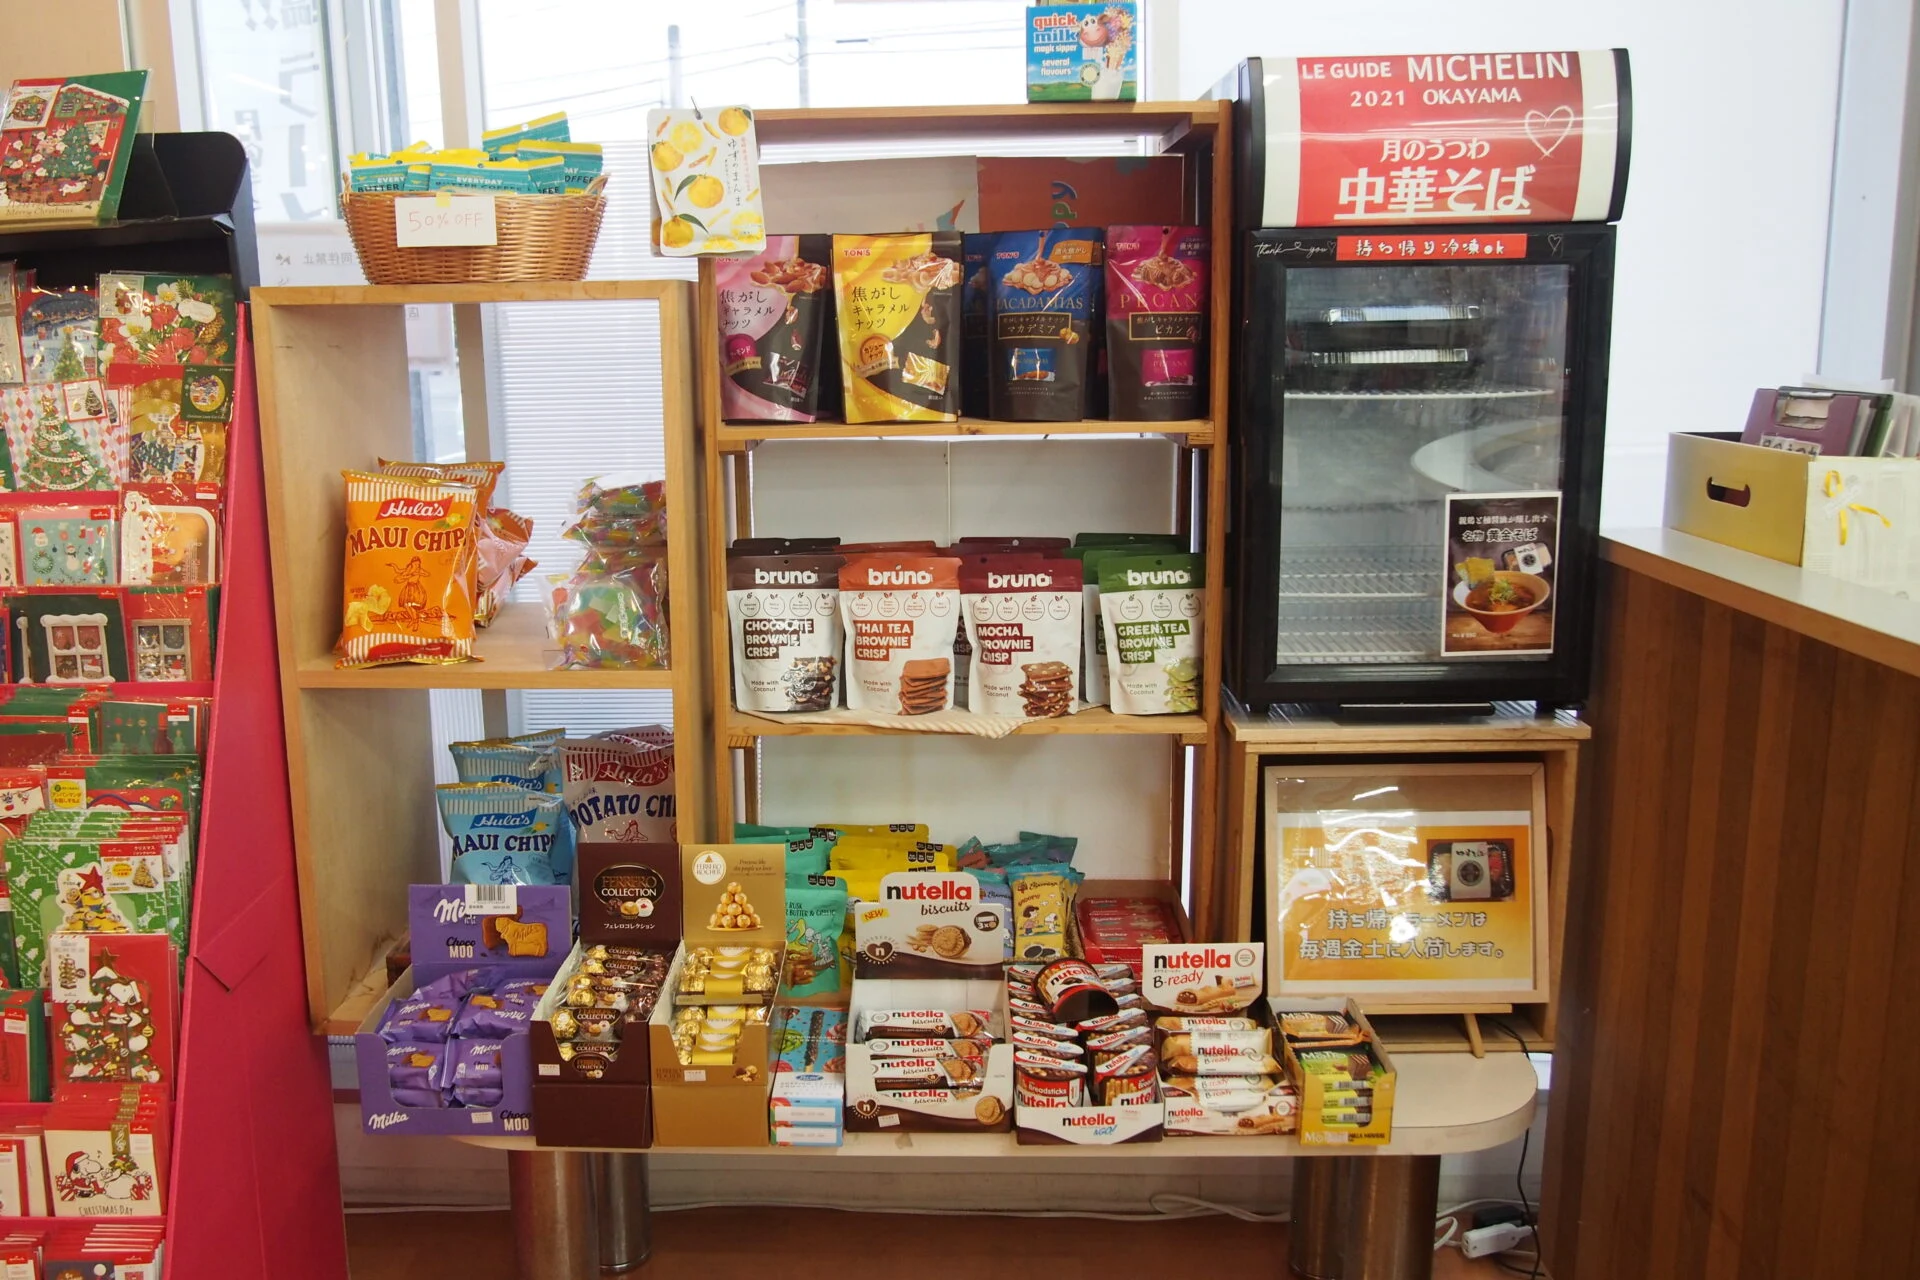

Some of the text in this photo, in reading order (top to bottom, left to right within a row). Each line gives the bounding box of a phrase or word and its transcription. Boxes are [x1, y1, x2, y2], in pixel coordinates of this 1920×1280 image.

[1034, 13, 1077, 30] quick
[1034, 28, 1078, 43] milk
[1034, 44, 1077, 54] magic sipper
[1042, 58, 1070, 66] several
[1302, 53, 1570, 83] LE GUIDE MICHELIN
[1041, 67, 1071, 76] flavours
[1351, 87, 1522, 107] 2021 OKAYAMA
[1379, 138, 1490, 162] 月のうつわ
[727, 138, 741, 206] ゆずのまんま
[456, 176, 502, 184] EVERYDAY
[1339, 164, 1536, 215] 中華そば
[409, 211, 484, 232] 50% OFF
[844, 249, 871, 257] TON'S
[720, 289, 767, 303] 焦がし
[852, 286, 900, 302] 焦がし
[721, 307, 775, 316] キャラメル
[852, 304, 910, 315] キャラメル
[722, 318, 751, 330] ナッツ
[855, 318, 886, 330] ナッツ
[1007, 325, 1056, 335] マカデミア
[380, 500, 444, 518] Hula's
[1487, 527, 1539, 542] 黄金そば
[350, 527, 407, 556] MAUI
[755, 569, 816, 585] bruno
[988, 572, 1051, 588] bruno
[1127, 569, 1189, 586] bruno
[856, 623, 911, 634] THAI TEA
[978, 626, 1020, 636] MOCHA
[1118, 624, 1187, 637] GREEN TEA
[746, 634, 800, 646] BROWNIE
[856, 636, 908, 647] BROWNIE
[747, 647, 777, 657] CRISP
[857, 649, 887, 659] CRISP
[982, 652, 1010, 662] CRISP
[1121, 651, 1152, 661] CRISP
[600, 762, 666, 784] Hula's
[570, 794, 640, 827] POTATO
[474, 814, 530, 828] Hula's
[452, 834, 499, 861] MAUI
[602, 876, 657, 888] FERRERO
[601, 888, 657, 897] COLLECTION
[887, 881, 972, 900] nutella
[921, 901, 971, 916] biscuits
[864, 910, 884, 920] NEW
[445, 937, 476, 946] Choco
[449, 946, 474, 958] MOO
[1299, 938, 1505, 960] 毎週金土に入荷します。
[1154, 949, 1231, 969] nutella
[606, 962, 641, 971] COLLECTION
[1153, 971, 1204, 989] B-ready
[1198, 1045, 1239, 1056] nutella
[881, 1059, 935, 1068] nutella
[1029, 1054, 1062, 1066] nutella
[903, 1067, 935, 1075] biscuits
[893, 1089, 948, 1098] nutella
[1028, 1084, 1067, 1095] Breadsticks
[500, 1110, 532, 1119] Choco
[1168, 1108, 1203, 1117] nutella
[368, 1112, 409, 1130] Milka
[504, 1118, 530, 1131] MOO
[1063, 1114, 1116, 1127] nutella
[78, 1206, 133, 1216] CHRISTMAS DAY
